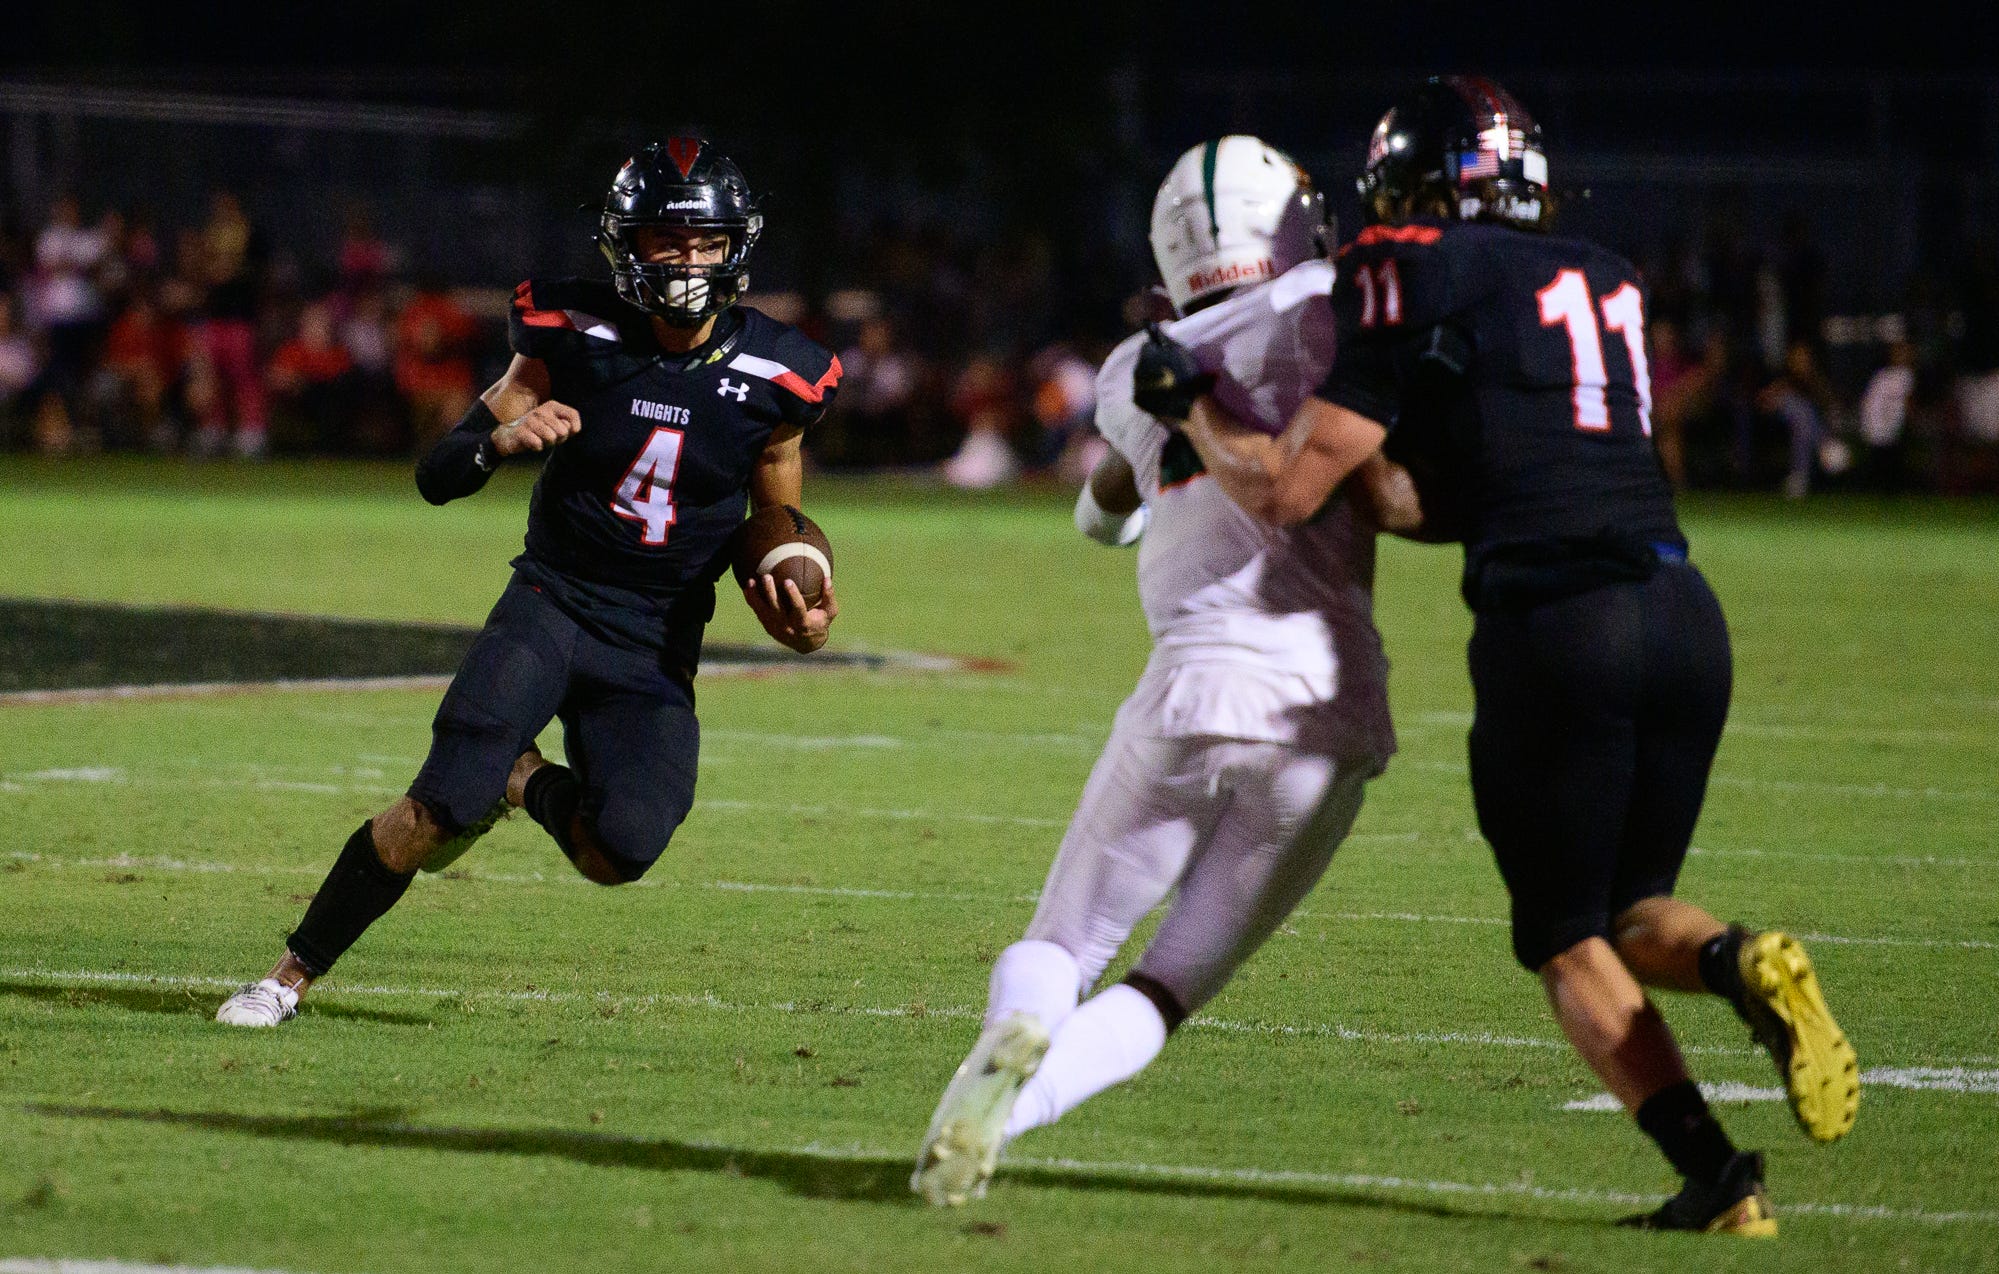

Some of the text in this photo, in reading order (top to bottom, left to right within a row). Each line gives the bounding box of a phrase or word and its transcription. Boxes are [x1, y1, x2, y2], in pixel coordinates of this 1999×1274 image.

[1353, 258, 1402, 328] 11
[1535, 267, 1652, 437] 11
[630, 398, 691, 425] KNIGHTS
[610, 425, 685, 546] 4
